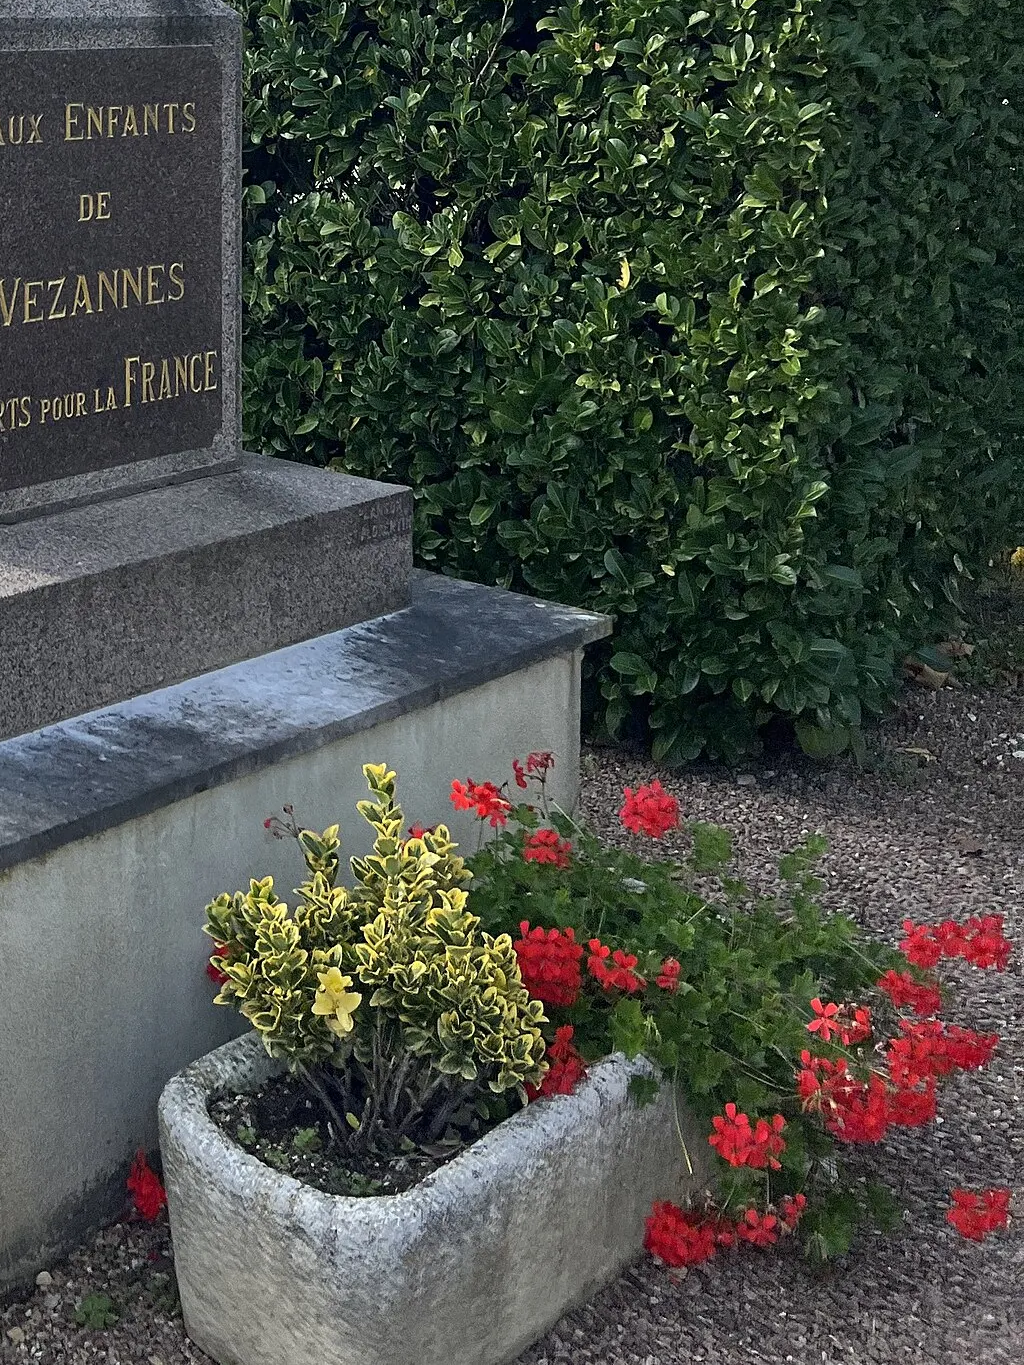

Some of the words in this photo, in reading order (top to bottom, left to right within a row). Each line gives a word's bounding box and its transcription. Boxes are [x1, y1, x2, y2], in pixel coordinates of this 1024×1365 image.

[63, 102, 197, 142] ENFANTS
[77, 191, 112, 222] DE
[39, 392, 88, 424] POUR
[93, 386, 118, 414] LA
[123, 350, 219, 408] FRANCE
